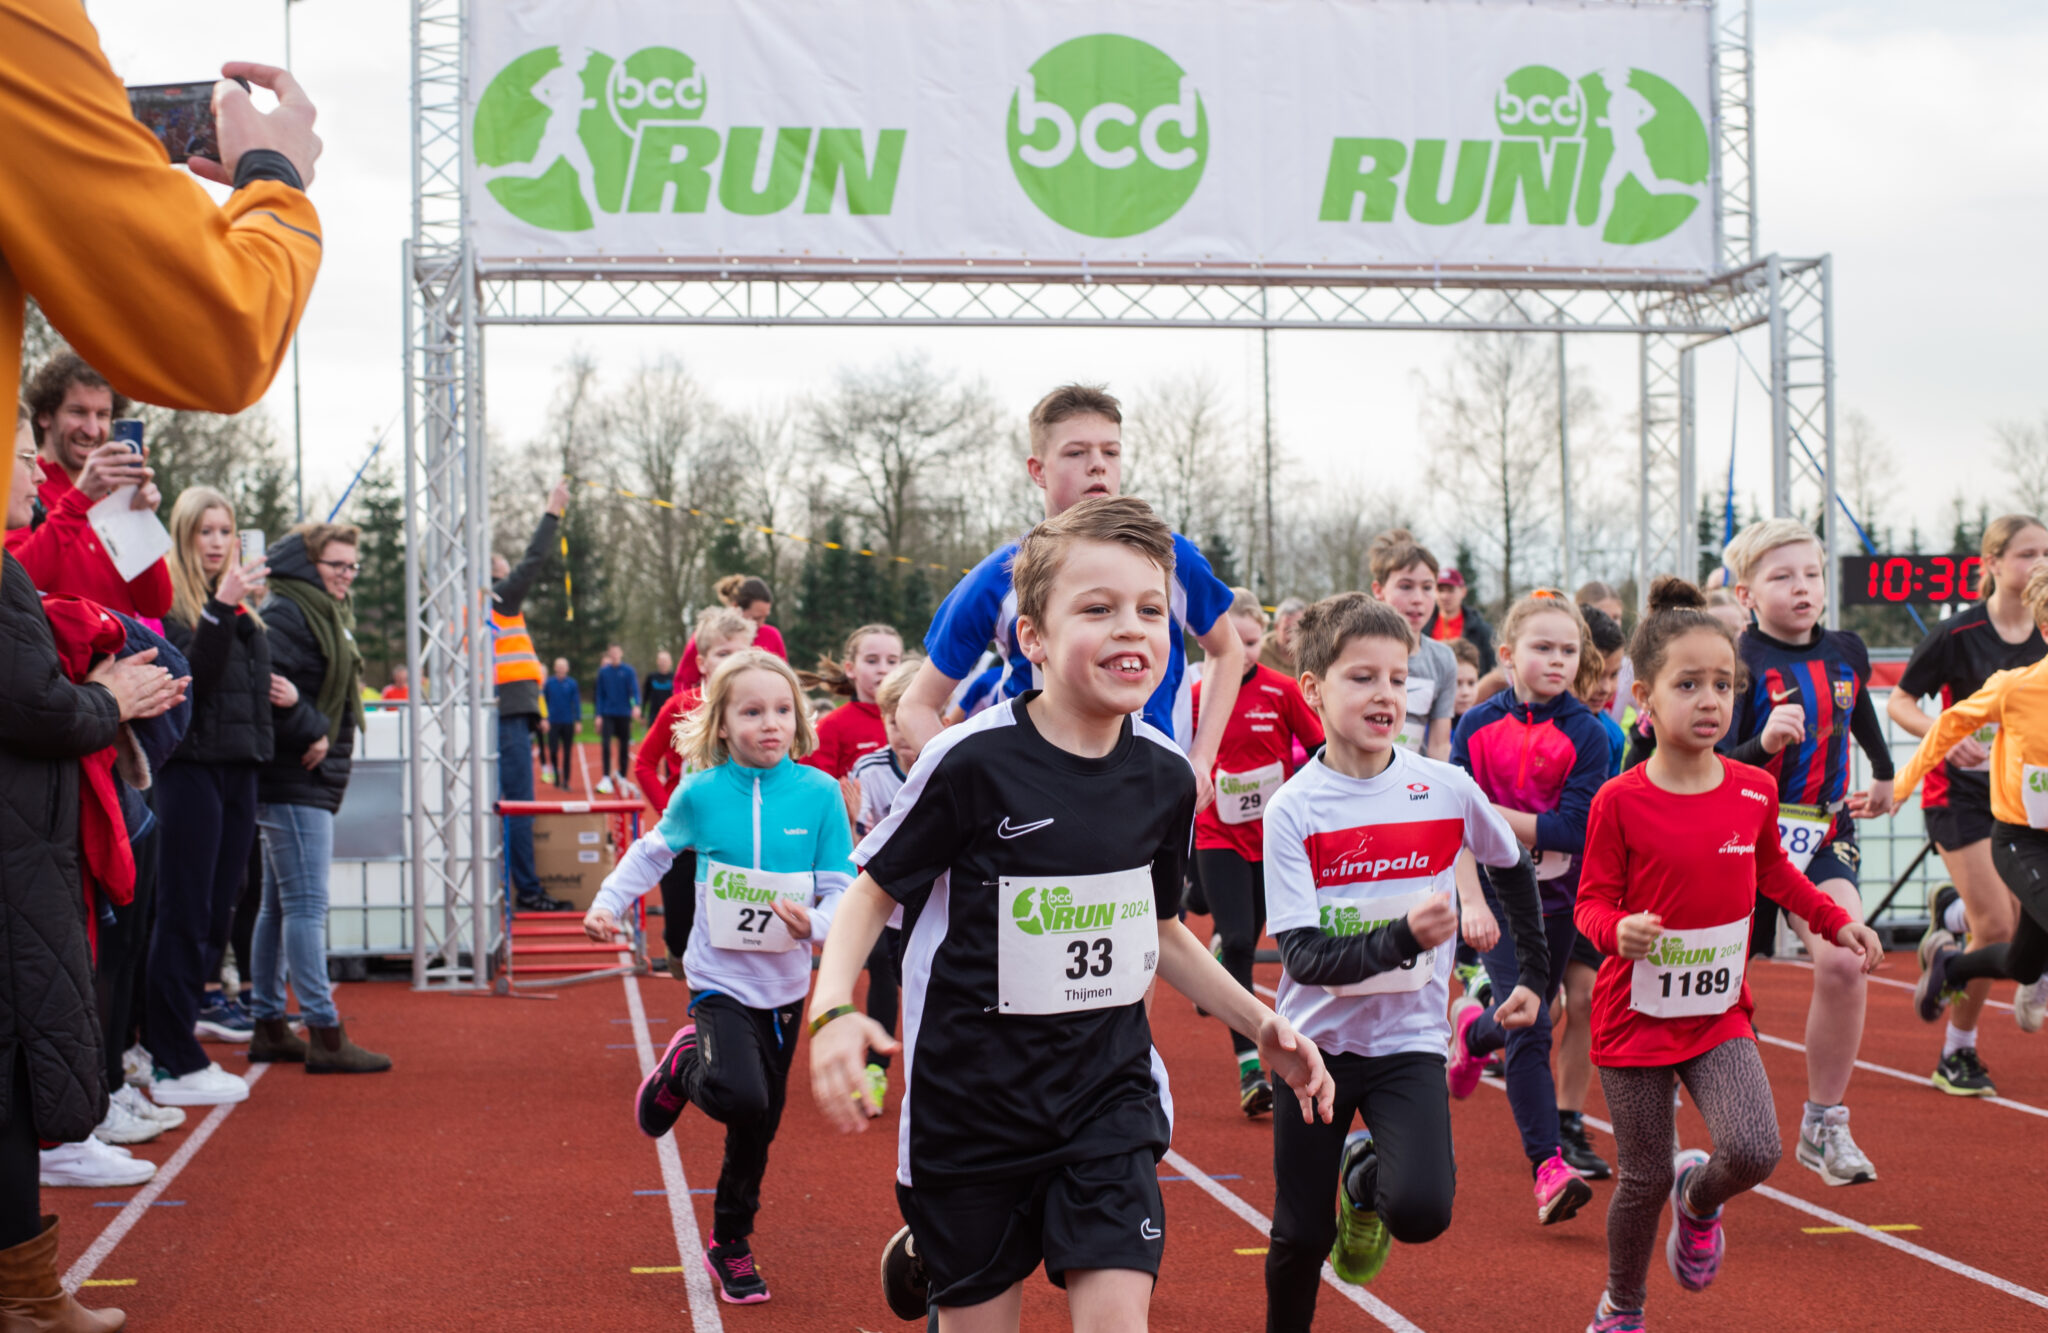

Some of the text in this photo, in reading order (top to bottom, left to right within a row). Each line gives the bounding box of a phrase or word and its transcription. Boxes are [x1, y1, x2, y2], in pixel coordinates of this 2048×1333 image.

[617, 66, 702, 109] bcd
[1499, 81, 1581, 125] bcd
[1018, 73, 1198, 170] bcd
[627, 126, 908, 215] RUN
[1317, 137, 1587, 226] RUN
[1240, 793, 1262, 811] 29
[1322, 851, 1430, 878] av impala
[732, 886, 778, 903] RUN
[1049, 892, 1072, 904] bcd
[737, 908, 773, 934] 27
[1051, 899, 1149, 930] RUN 2024
[1065, 938, 1113, 980] 33
[1668, 942, 1742, 965] RUN 2024
[1065, 987, 1112, 1002] Thijmen
[1658, 967, 1730, 998] 1189
